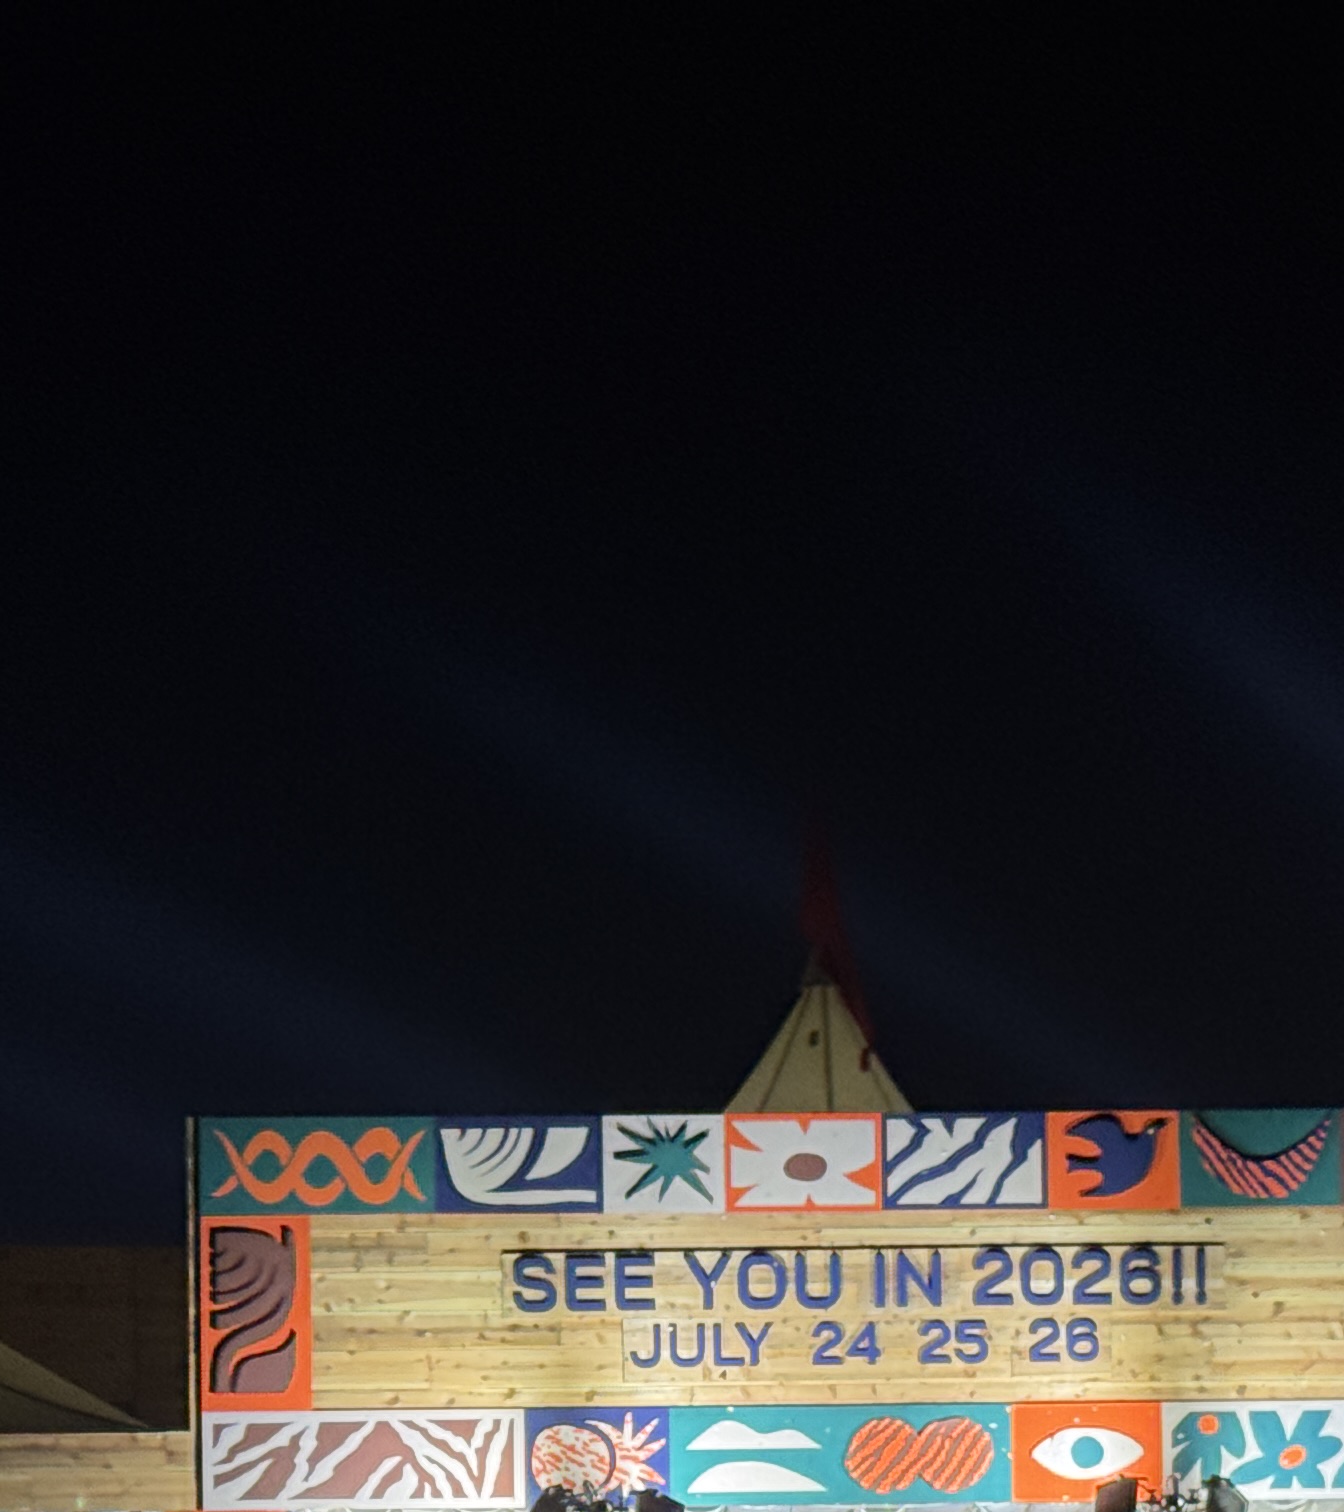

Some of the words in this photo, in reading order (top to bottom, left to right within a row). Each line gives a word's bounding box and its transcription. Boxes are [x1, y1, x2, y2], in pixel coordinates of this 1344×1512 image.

[512, 1250, 656, 1312] SEE
[683, 1249, 843, 1311] YOU
[873, 1248, 942, 1308] IN
[972, 1244, 1207, 1306] 2026!!
[629, 1321, 774, 1368] JULY
[811, 1320, 881, 1366] 24
[917, 1319, 989, 1364] 25
[1028, 1317, 1099, 1362] 26
